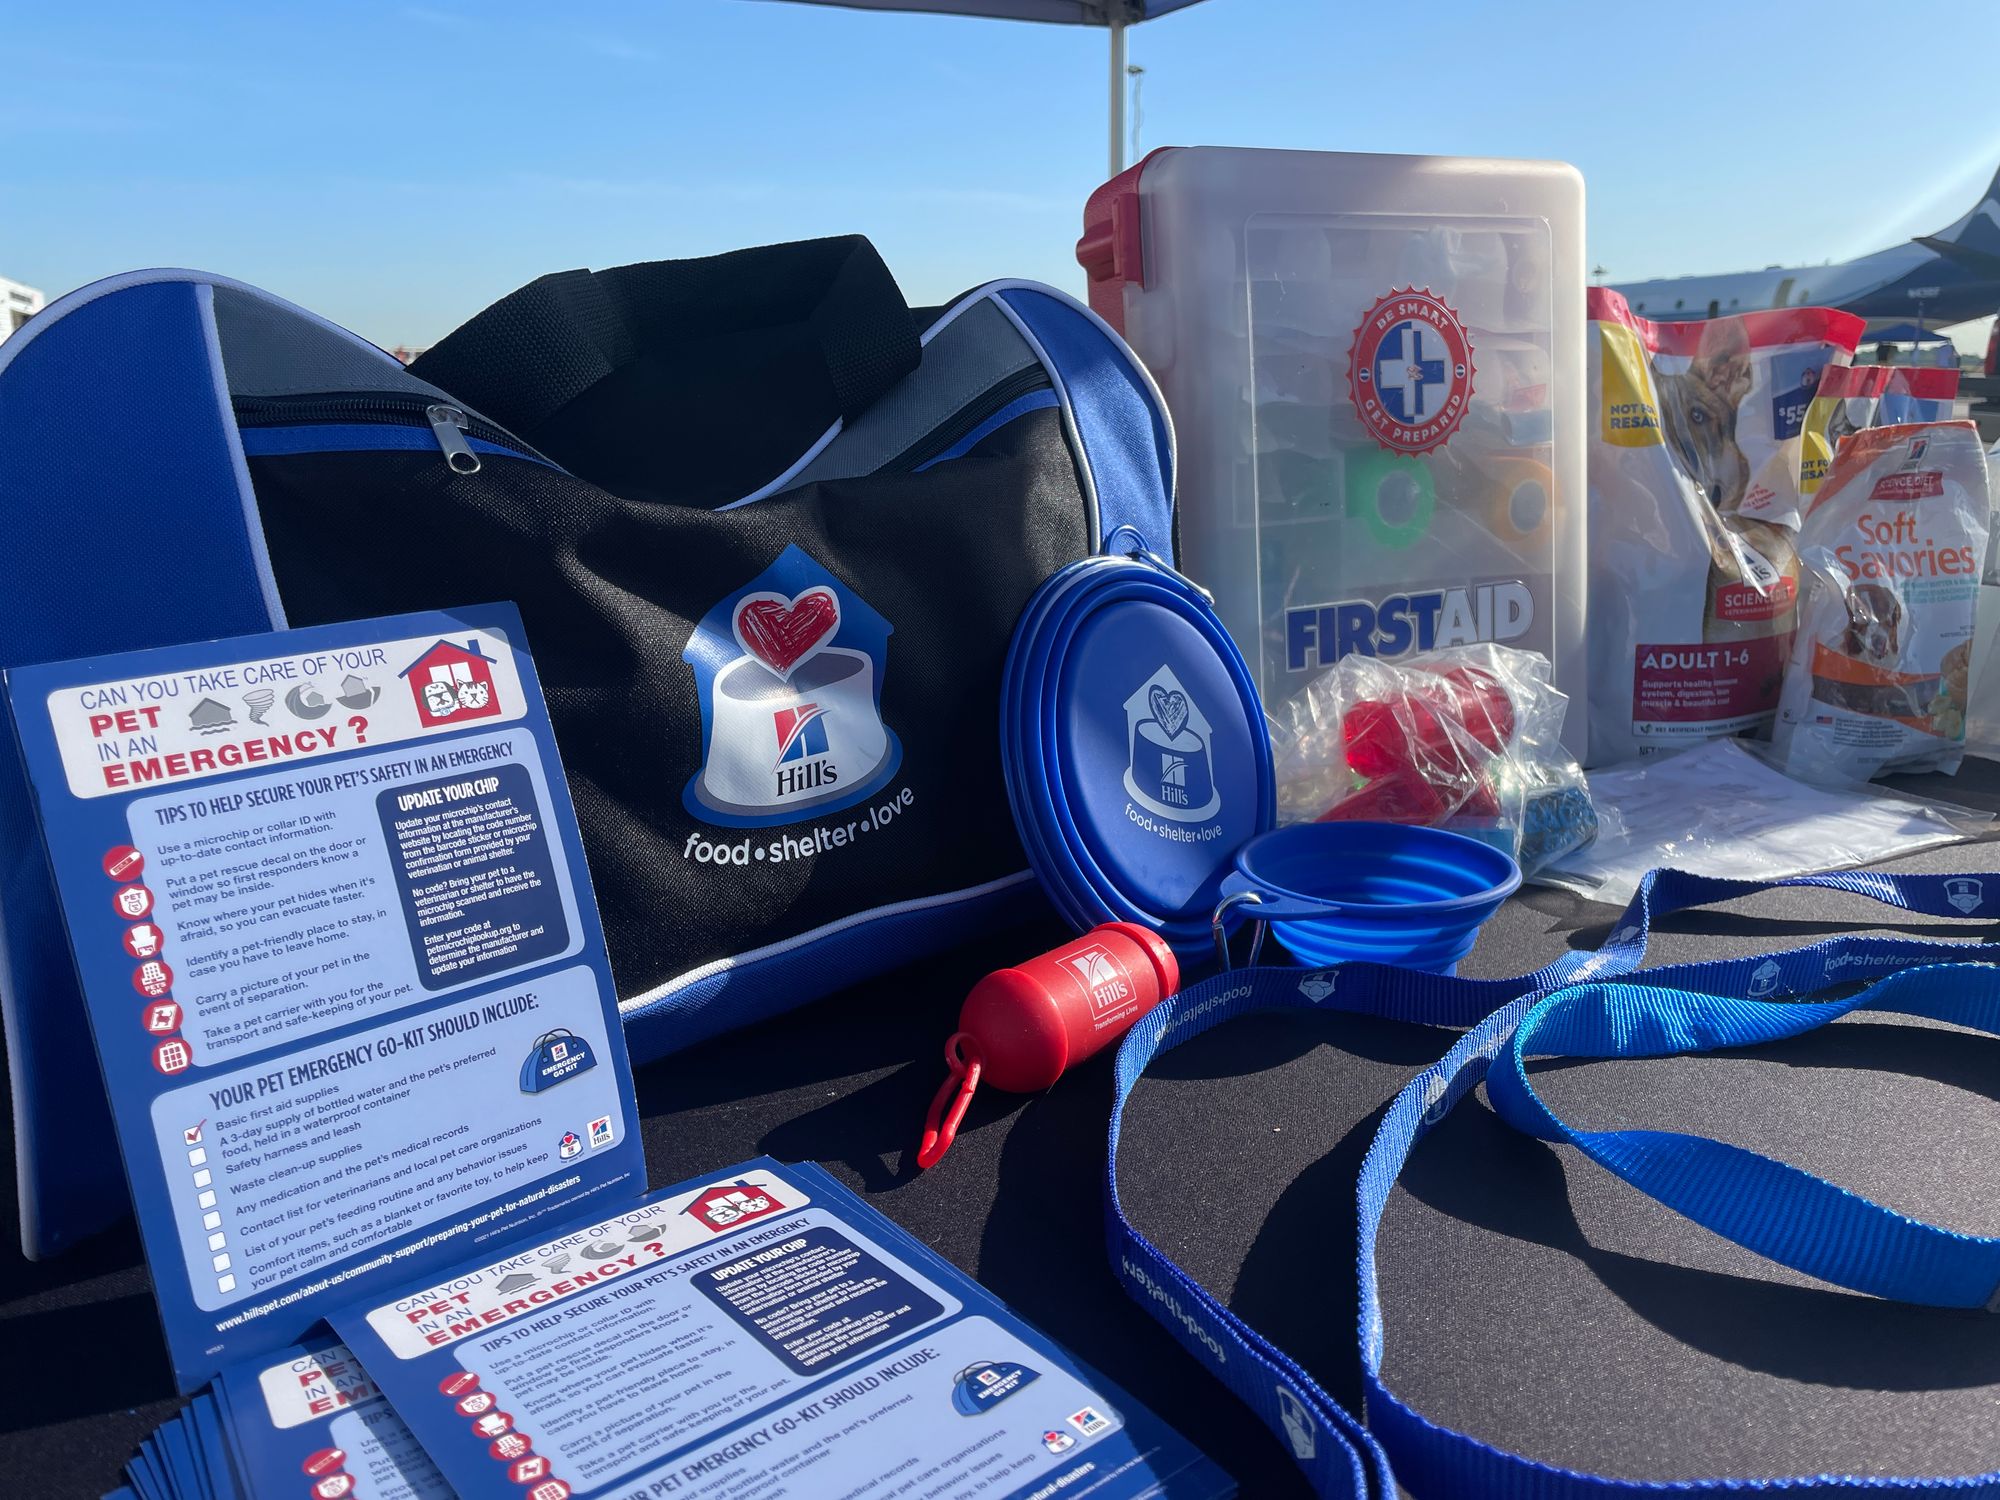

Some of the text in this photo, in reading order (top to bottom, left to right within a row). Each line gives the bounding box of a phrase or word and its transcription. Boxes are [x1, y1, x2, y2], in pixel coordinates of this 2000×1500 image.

[1376, 303, 1449, 330] BE SMART
[1365, 395, 1460, 442] GET PREPARED
[1611, 403, 1638, 415] NOT
[1857, 512, 1918, 545] Soft
[1835, 539, 1976, 582] Savories
[1642, 649, 1749, 669] ADULT 1-6
[80, 648, 387, 710] CAN YOU TAKE CARE OF YOUR
[88, 705, 161, 738] PET
[97, 735, 158, 761] IN AN
[102, 725, 337, 788] EMERGENCY
[154, 741, 512, 825] TIPS TO HELP SECURE YOUR PET'S SAFETY IN AN EMERGENCY
[397, 776, 499, 811] UPDATE YOUR CHIP
[776, 758, 838, 797] Hill's
[1161, 785, 1189, 806] Hill's
[394, 797, 512, 830] Update your microchip's contact
[683, 787, 914, 866] food shelter love
[157, 810, 336, 855] Use a microchip or collar ID with
[160, 824, 333, 867] up-to-date contact information.
[1159, 824, 1196, 843] shelter
[1201, 825, 1223, 841] love
[124, 893, 142, 902] PET
[198, 981, 309, 1017] event of separation.
[1093, 980, 1129, 1009] Hill's
[1094, 1004, 1138, 1032] Transforming Lives
[209, 992, 539, 1110] YOUR PET EMERGENCY GO-KIT SHOULD INCLUDE:
[542, 1052, 586, 1076] EMERGENCY
[553, 1062, 578, 1078] GO KIT
[215, 1085, 340, 1131] Basic first aid supplies
[225, 1121, 361, 1174] Safety harness and leash
[229, 1143, 362, 1195] Waste clean-up supplies
[395, 1205, 667, 1313] CAN YOU TAKE CARE OF YOUR
[710, 1238, 807, 1281] UPDATE YOUR CHIP
[424, 1254, 638, 1346] EMERGENCY
[480, 1217, 810, 1352] TIPS TO HELP SECURE YOUR PET'S SAFETY IN AN EMERGENCY
[406, 1292, 471, 1324] PET
[417, 1307, 473, 1335] IN AN
[292, 1350, 337, 1373] CAN
[305, 1385, 326, 1400] IN
[335, 1373, 364, 1389] AN
[652, 1348, 940, 1499] PET EMERGENCY GO-KIT SHOULD INCLUDE:
